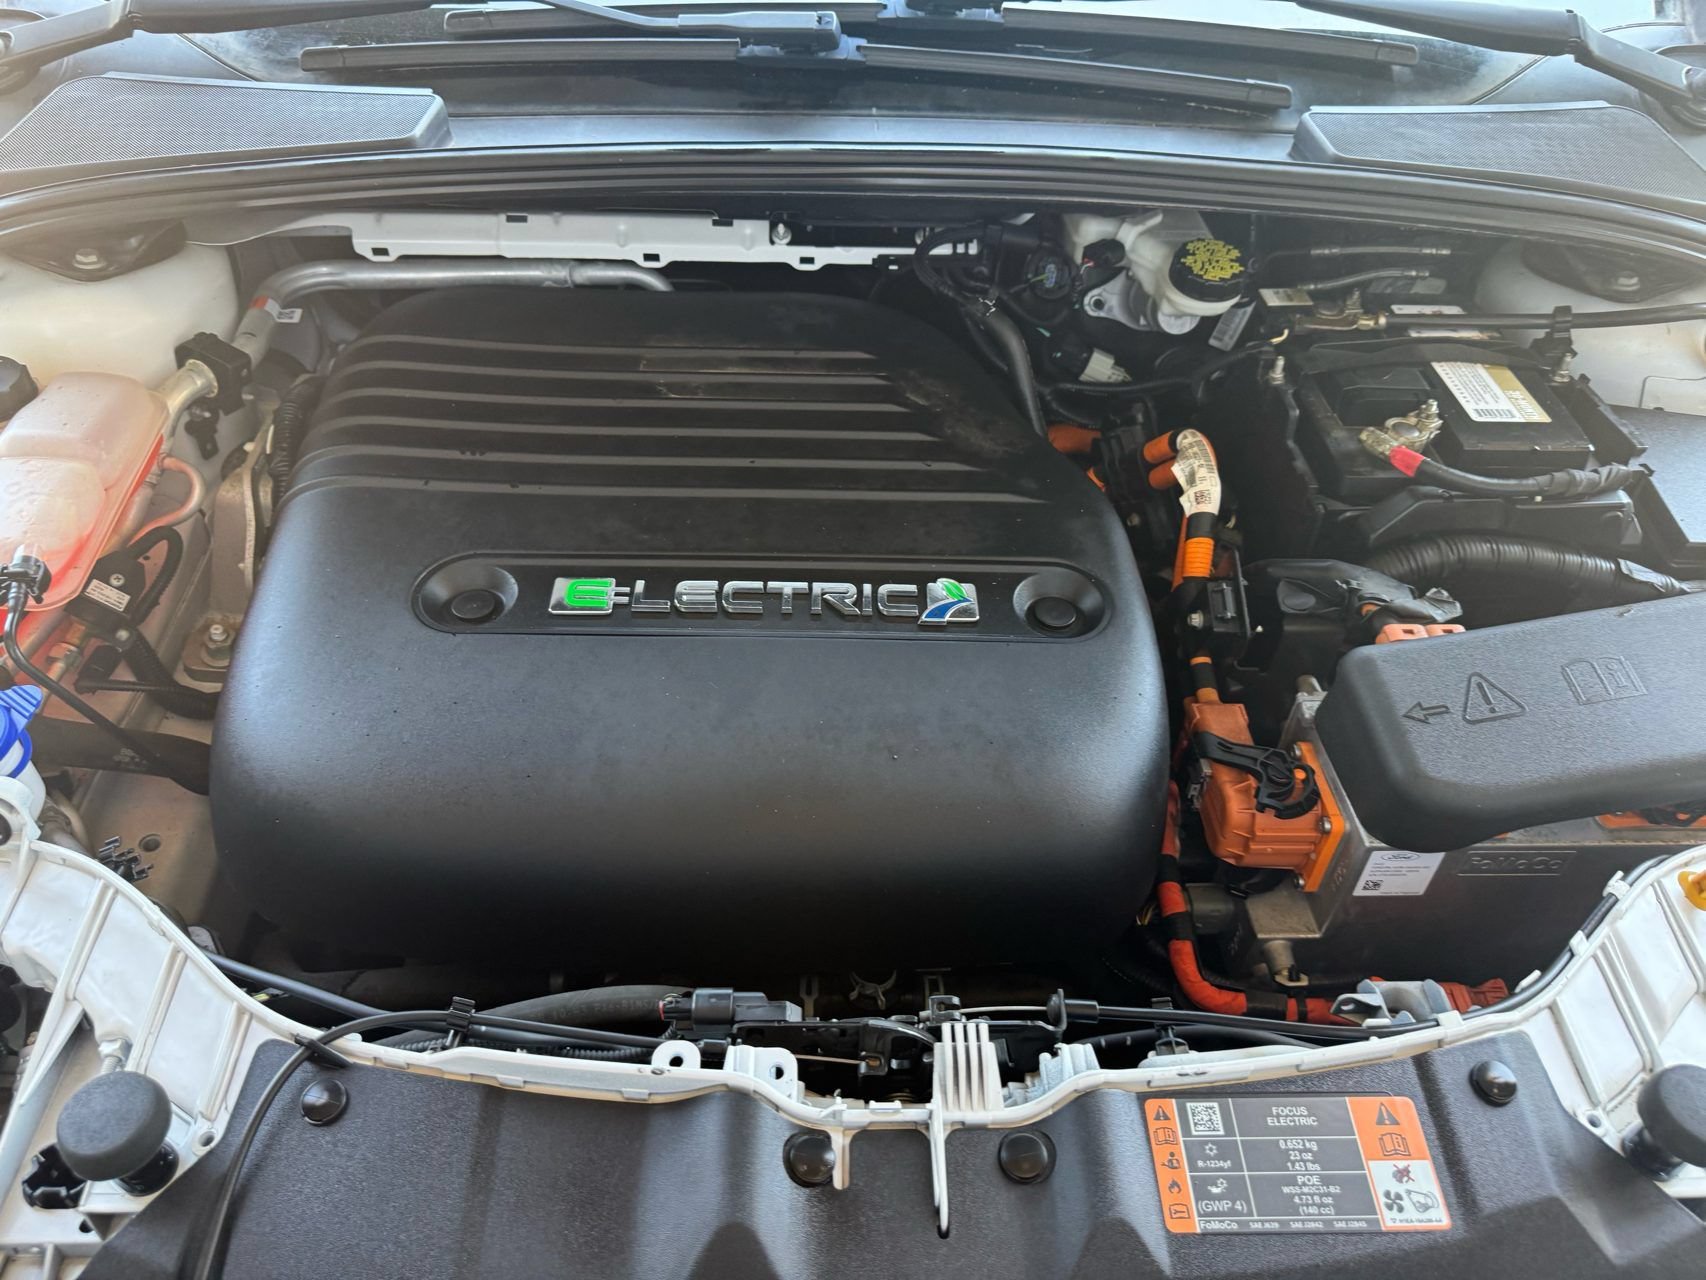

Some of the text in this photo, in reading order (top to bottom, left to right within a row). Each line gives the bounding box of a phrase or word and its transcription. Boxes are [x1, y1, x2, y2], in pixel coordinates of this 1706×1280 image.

[1272, 1106, 1308, 1116] FOCUS
[1266, 1116, 1319, 1126] ELECTRIC
[1279, 1139, 1318, 1151] 0.652 kg
[1288, 1151, 1314, 1160] 23 oz
[1197, 1160, 1232, 1169] R-1234yf
[1286, 1161, 1321, 1171] 1.43 lbs
[1296, 1175, 1322, 1185] POE
[1293, 1195, 1312, 1204] 4.73
[1321, 1196, 1334, 1204] oz
[1198, 1200, 1247, 1214] (GWP 4)
[1299, 1205, 1335, 1216] (140 cc)
[1199, 1220, 1238, 1230] FoMoCo
